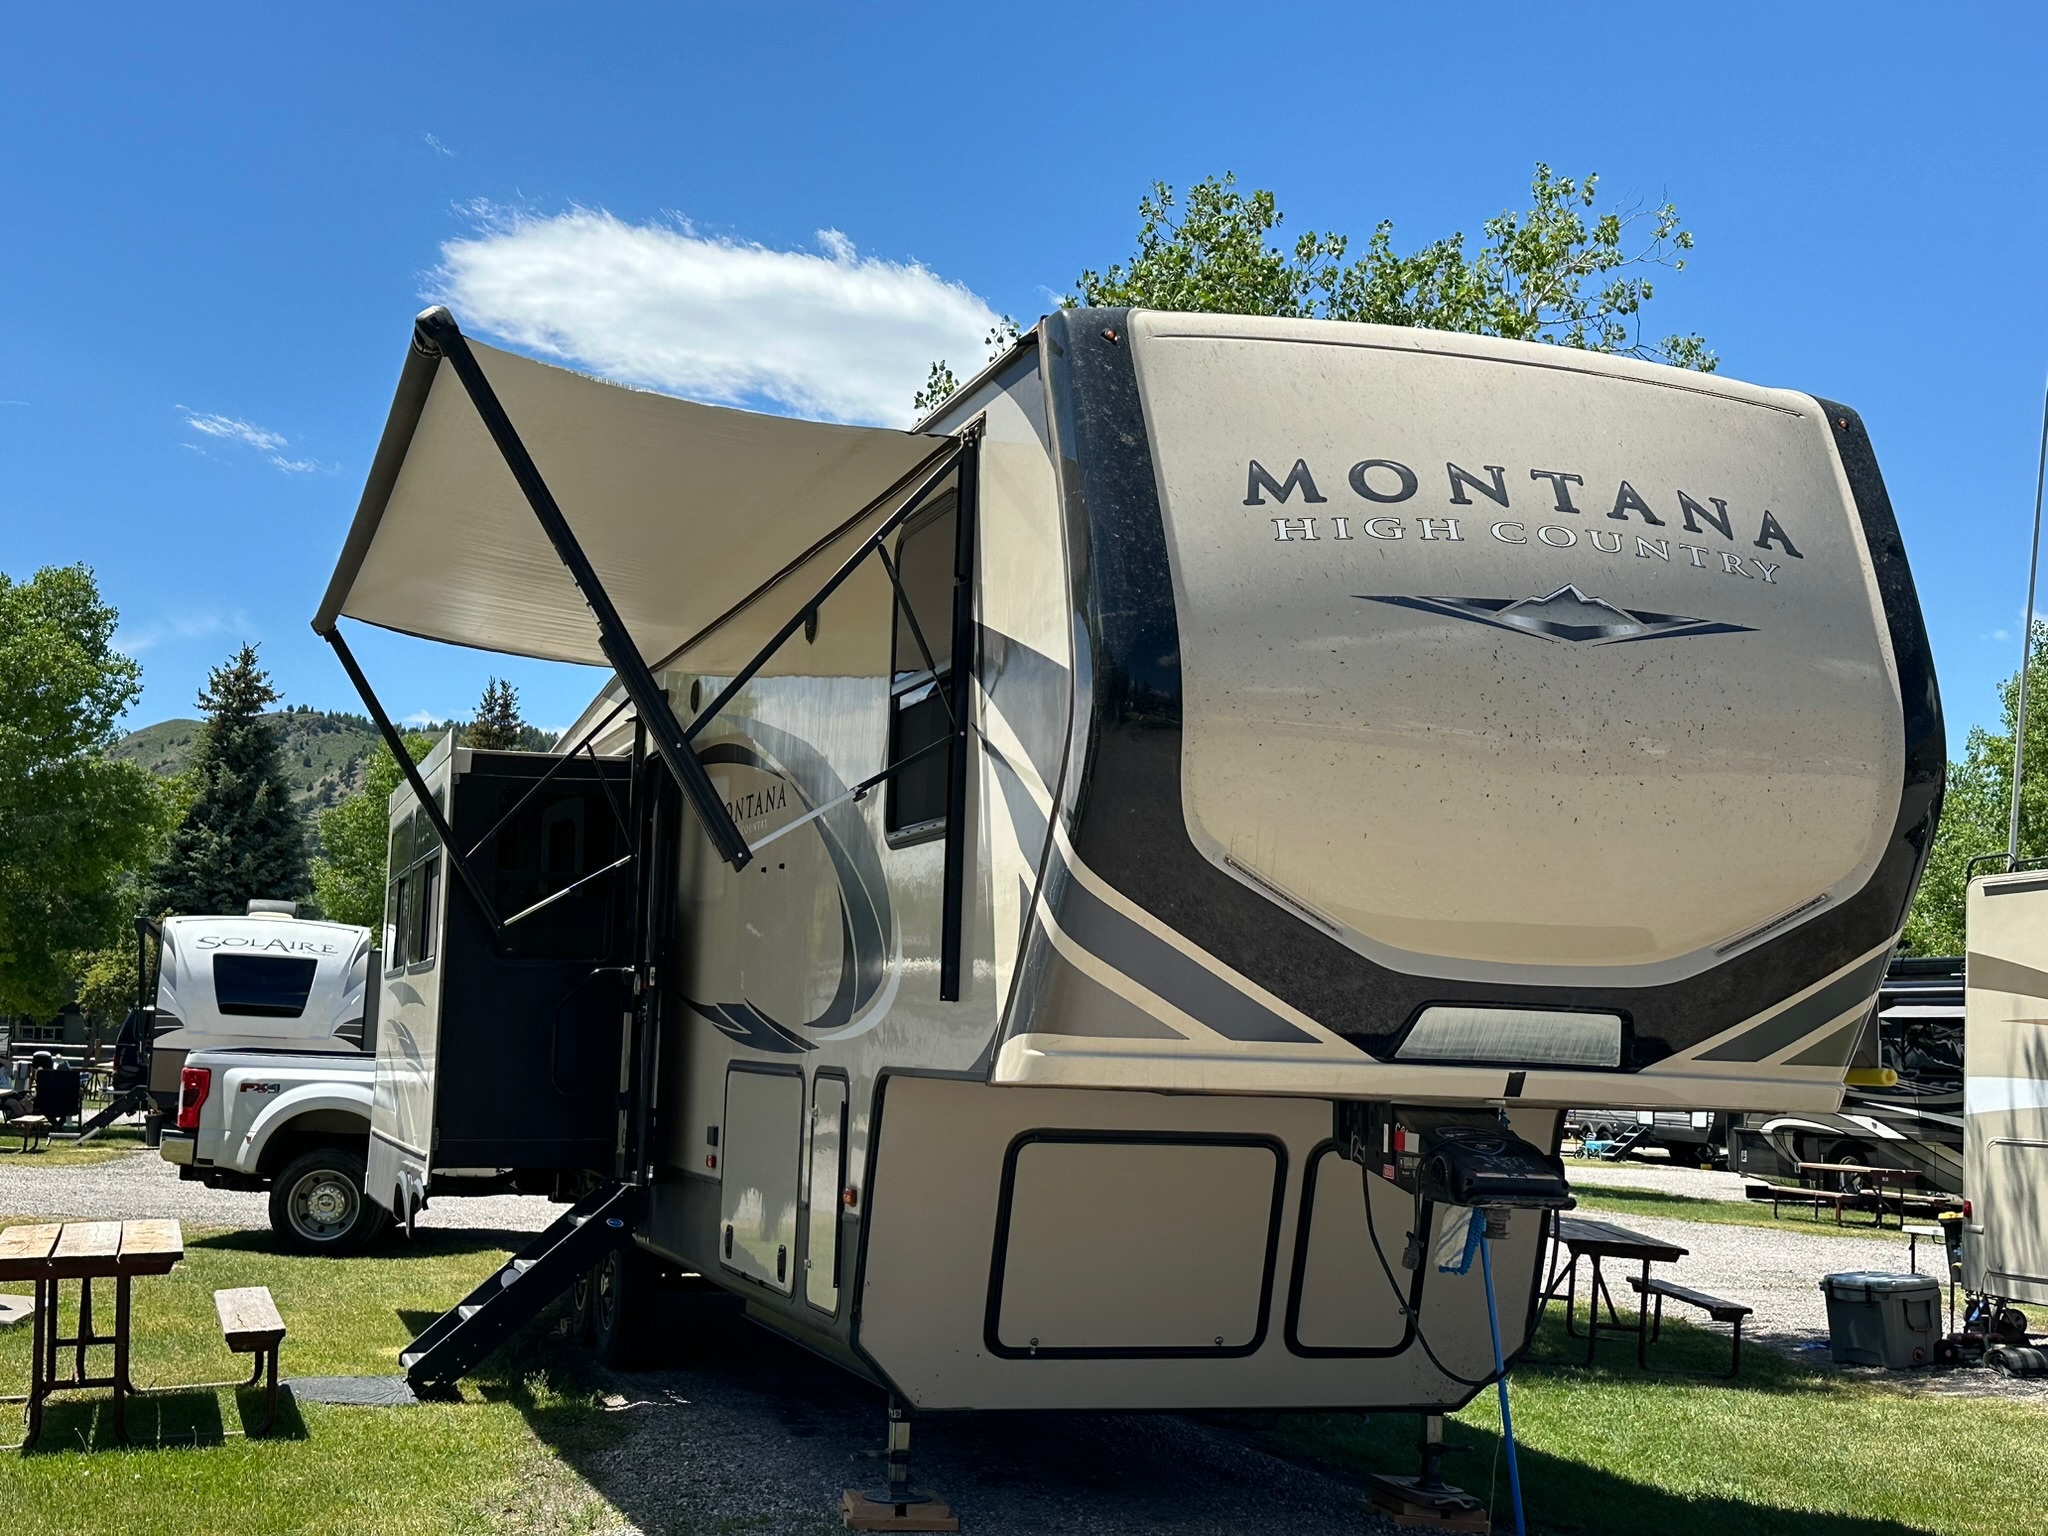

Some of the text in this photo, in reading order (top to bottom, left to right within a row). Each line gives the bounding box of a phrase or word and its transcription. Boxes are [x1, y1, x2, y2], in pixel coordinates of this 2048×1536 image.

[1243, 458, 1804, 559] MONTANA
[1273, 516, 1781, 585] HIGH COUNTRY
[725, 782, 787, 824] ONTANA
[239, 1082, 281, 1094] FX4
